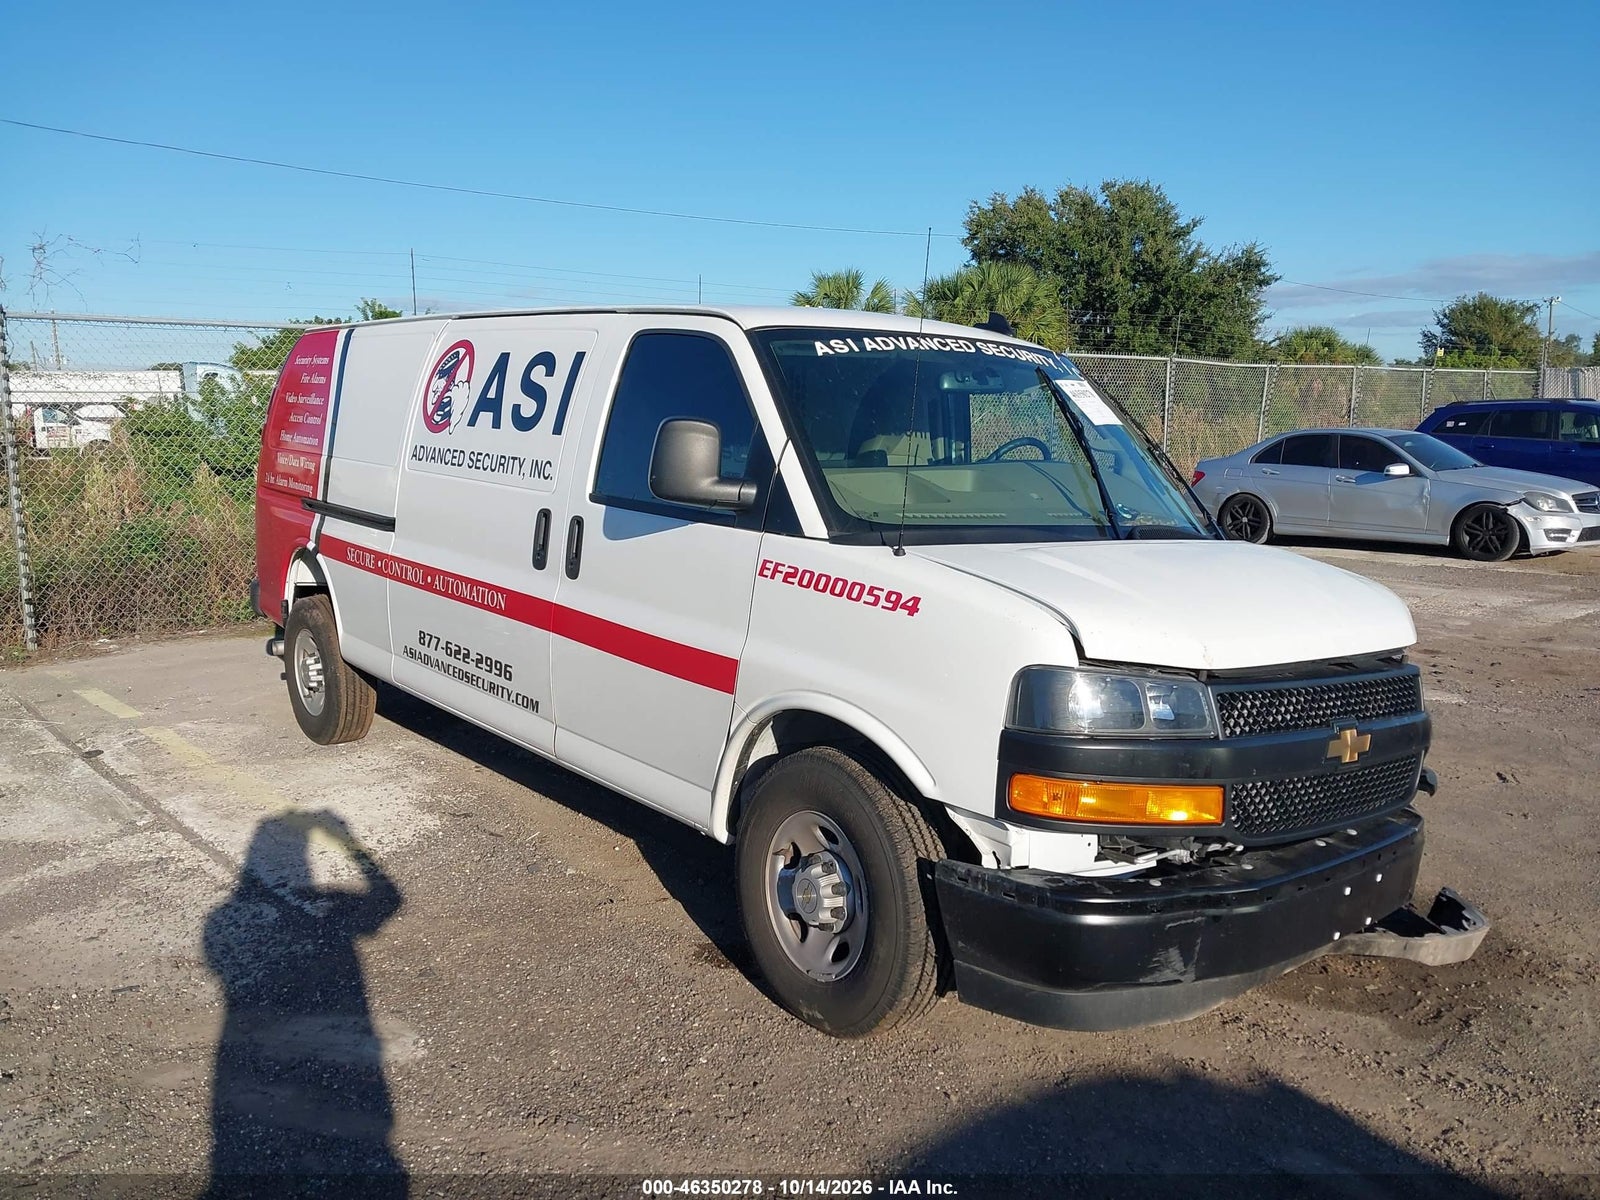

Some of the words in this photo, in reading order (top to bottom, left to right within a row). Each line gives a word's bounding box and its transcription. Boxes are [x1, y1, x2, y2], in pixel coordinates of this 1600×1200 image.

[814, 337, 860, 357] ASI
[862, 336, 976, 353] ADVANCED
[285, 391, 298, 403] Video
[297, 392, 325, 405] Surveillance
[303, 411, 323, 425] Control
[467, 351, 587, 436] ASI
[411, 445, 466, 467] ADVANCED
[467, 450, 526, 480] SECURITY,
[529, 459, 553, 481] INC.
[346, 546, 375, 569] SECURE
[381, 558, 425, 586] CONTROL
[432, 574, 507, 611] AUTOMATION
[757, 559, 922, 617] EF20000594
[402, 645, 540, 714] ASIADVANCEDSECURITY.COM
[418, 630, 513, 682] 877-622-2996
